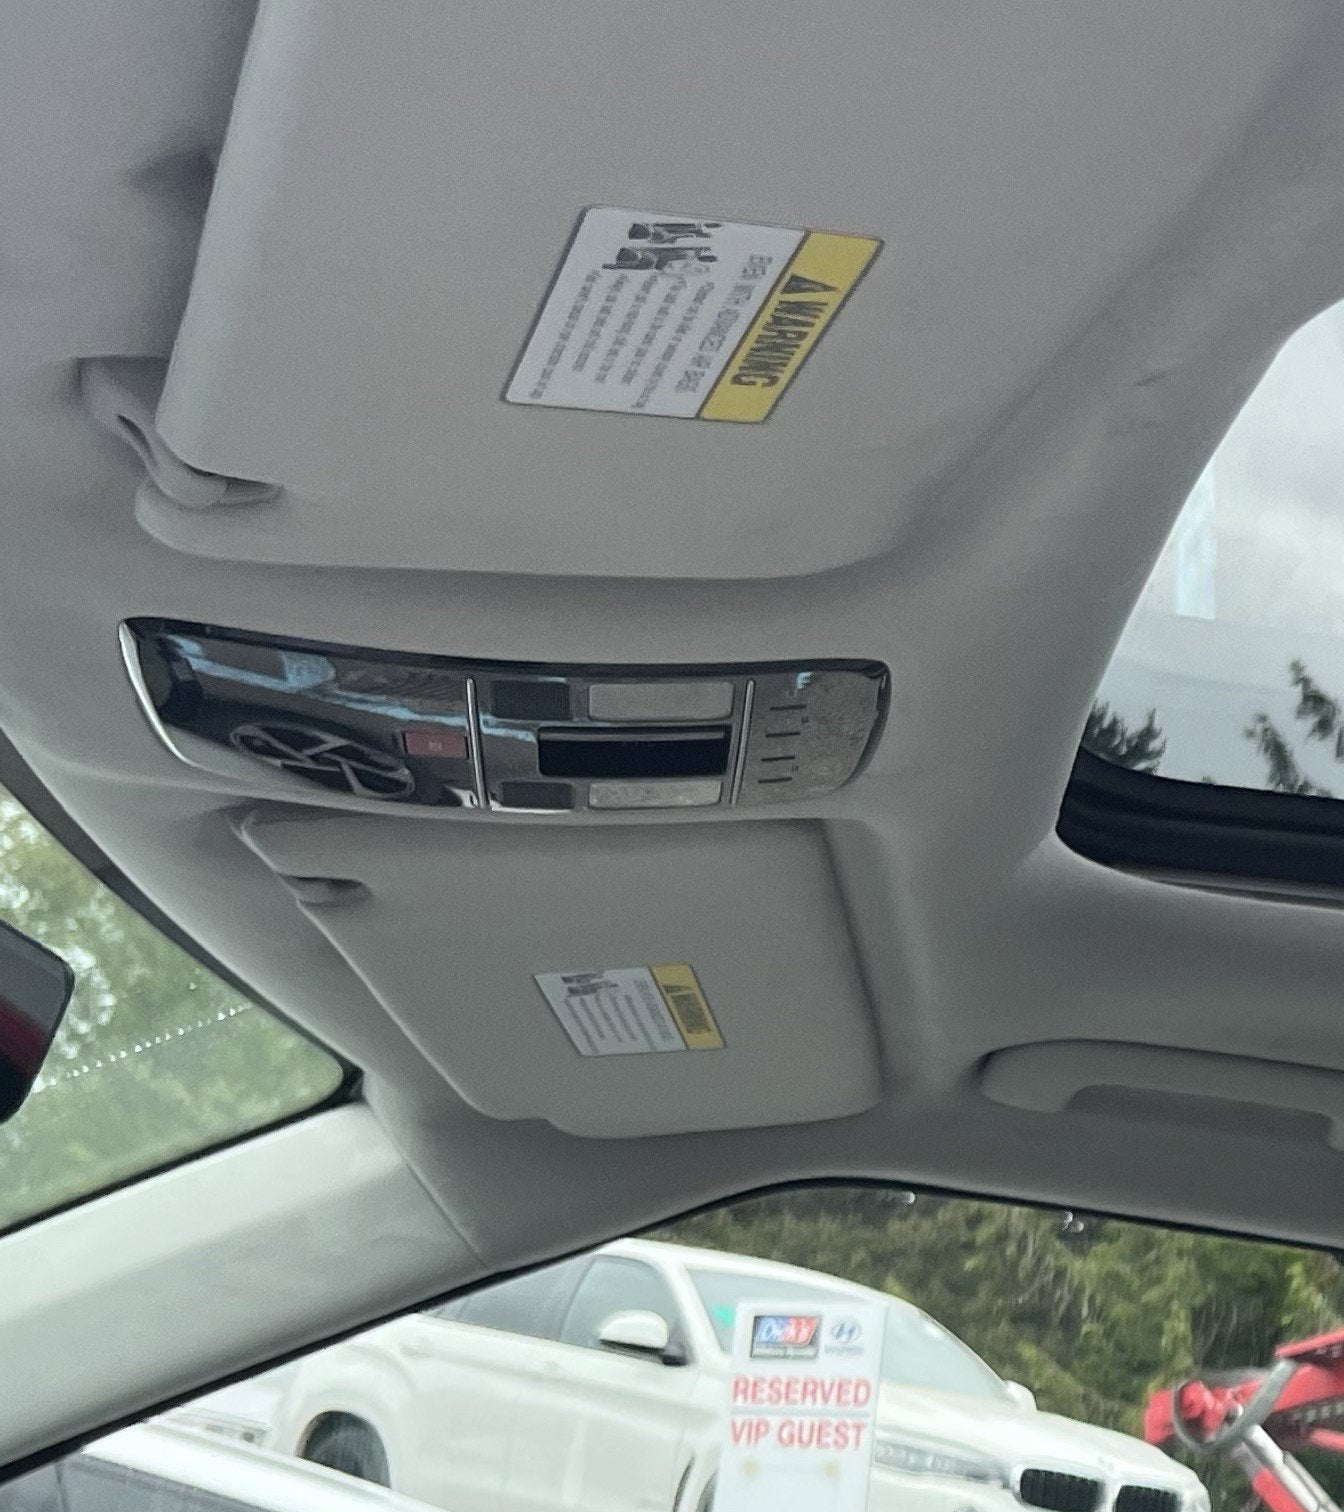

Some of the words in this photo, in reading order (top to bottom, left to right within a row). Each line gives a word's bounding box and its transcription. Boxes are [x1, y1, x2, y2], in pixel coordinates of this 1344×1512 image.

[730, 301, 829, 388] WARNING
[732, 1375, 872, 1407] RESERVED
[731, 1417, 770, 1448] VIP
[777, 1418, 868, 1451] GUEST
